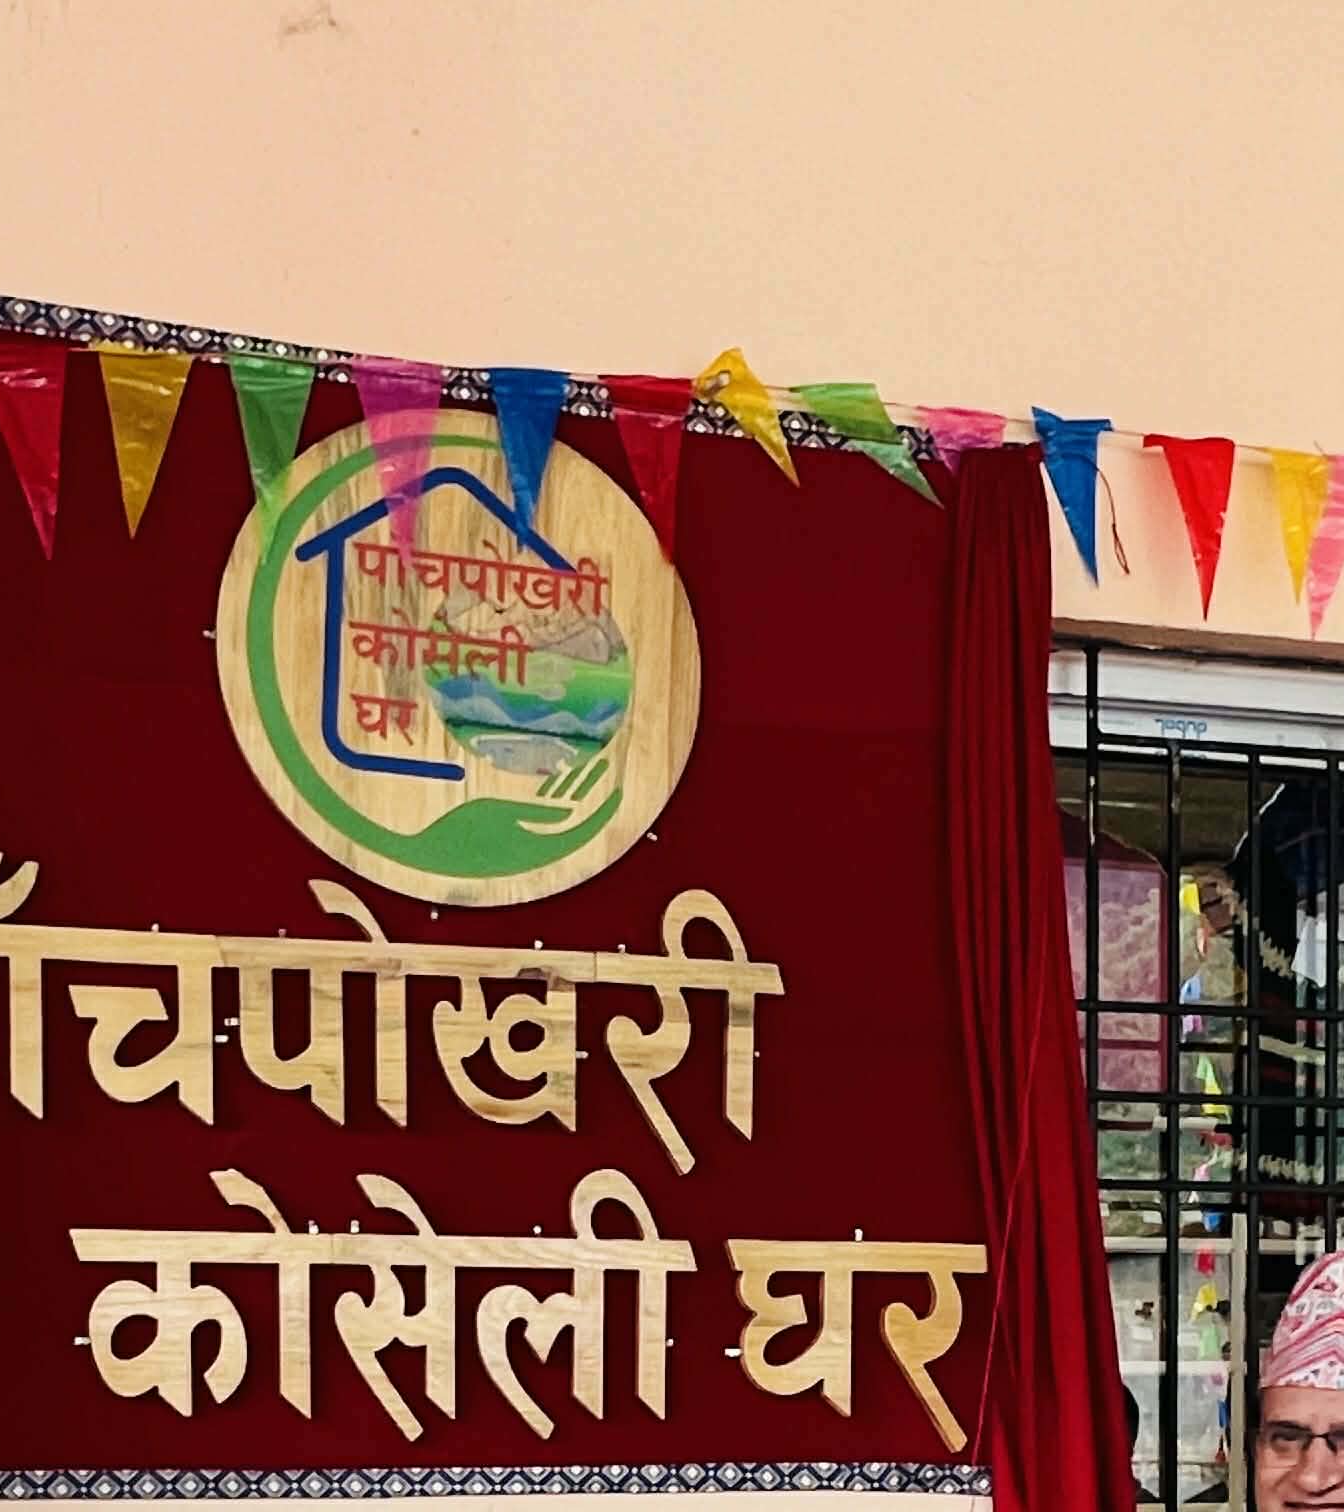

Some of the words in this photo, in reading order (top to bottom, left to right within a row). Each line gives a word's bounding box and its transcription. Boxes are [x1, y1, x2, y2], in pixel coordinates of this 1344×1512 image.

[349, 607, 534, 687] कोसेली
[350, 694, 418, 746] घर
[69, 1169, 697, 1441] कोसेली
[727, 1240, 988, 1453] घर
